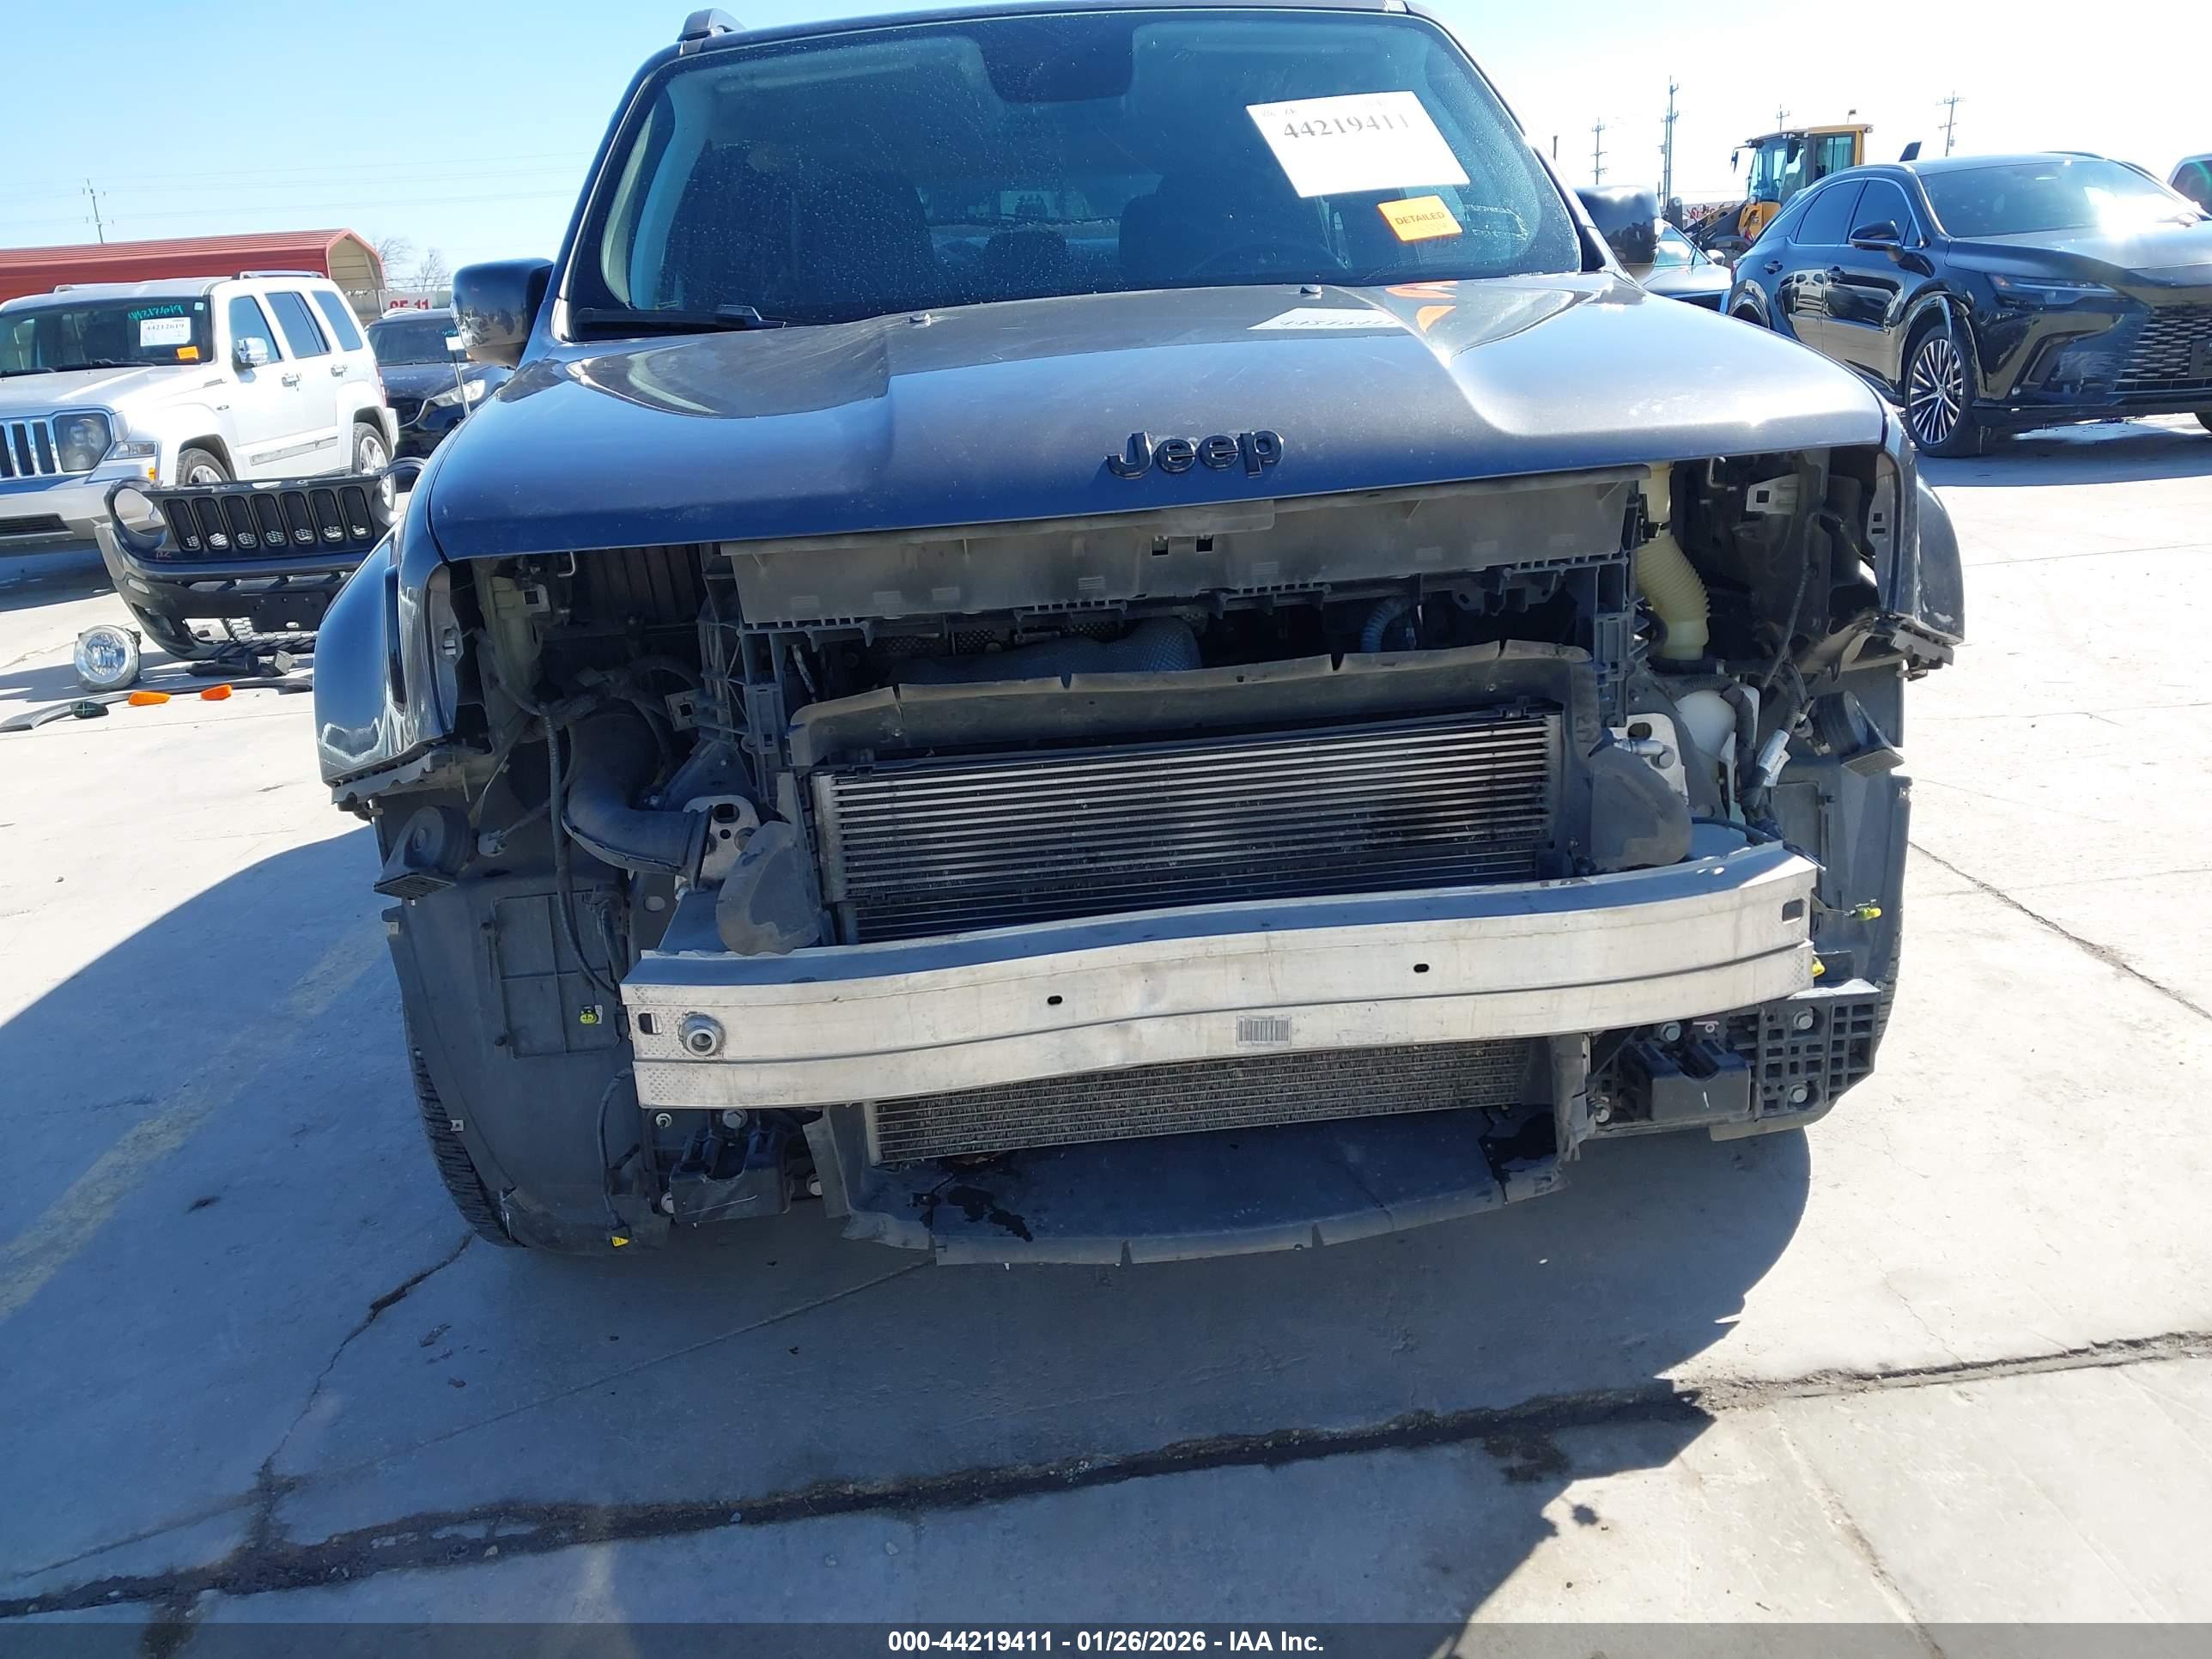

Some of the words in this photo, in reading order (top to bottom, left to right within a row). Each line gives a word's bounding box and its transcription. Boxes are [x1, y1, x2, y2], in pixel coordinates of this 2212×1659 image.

[1284, 113, 1409, 138] 44219411
[1395, 212, 1445, 225] DETAILED
[1103, 430, 1285, 478] Jeep
